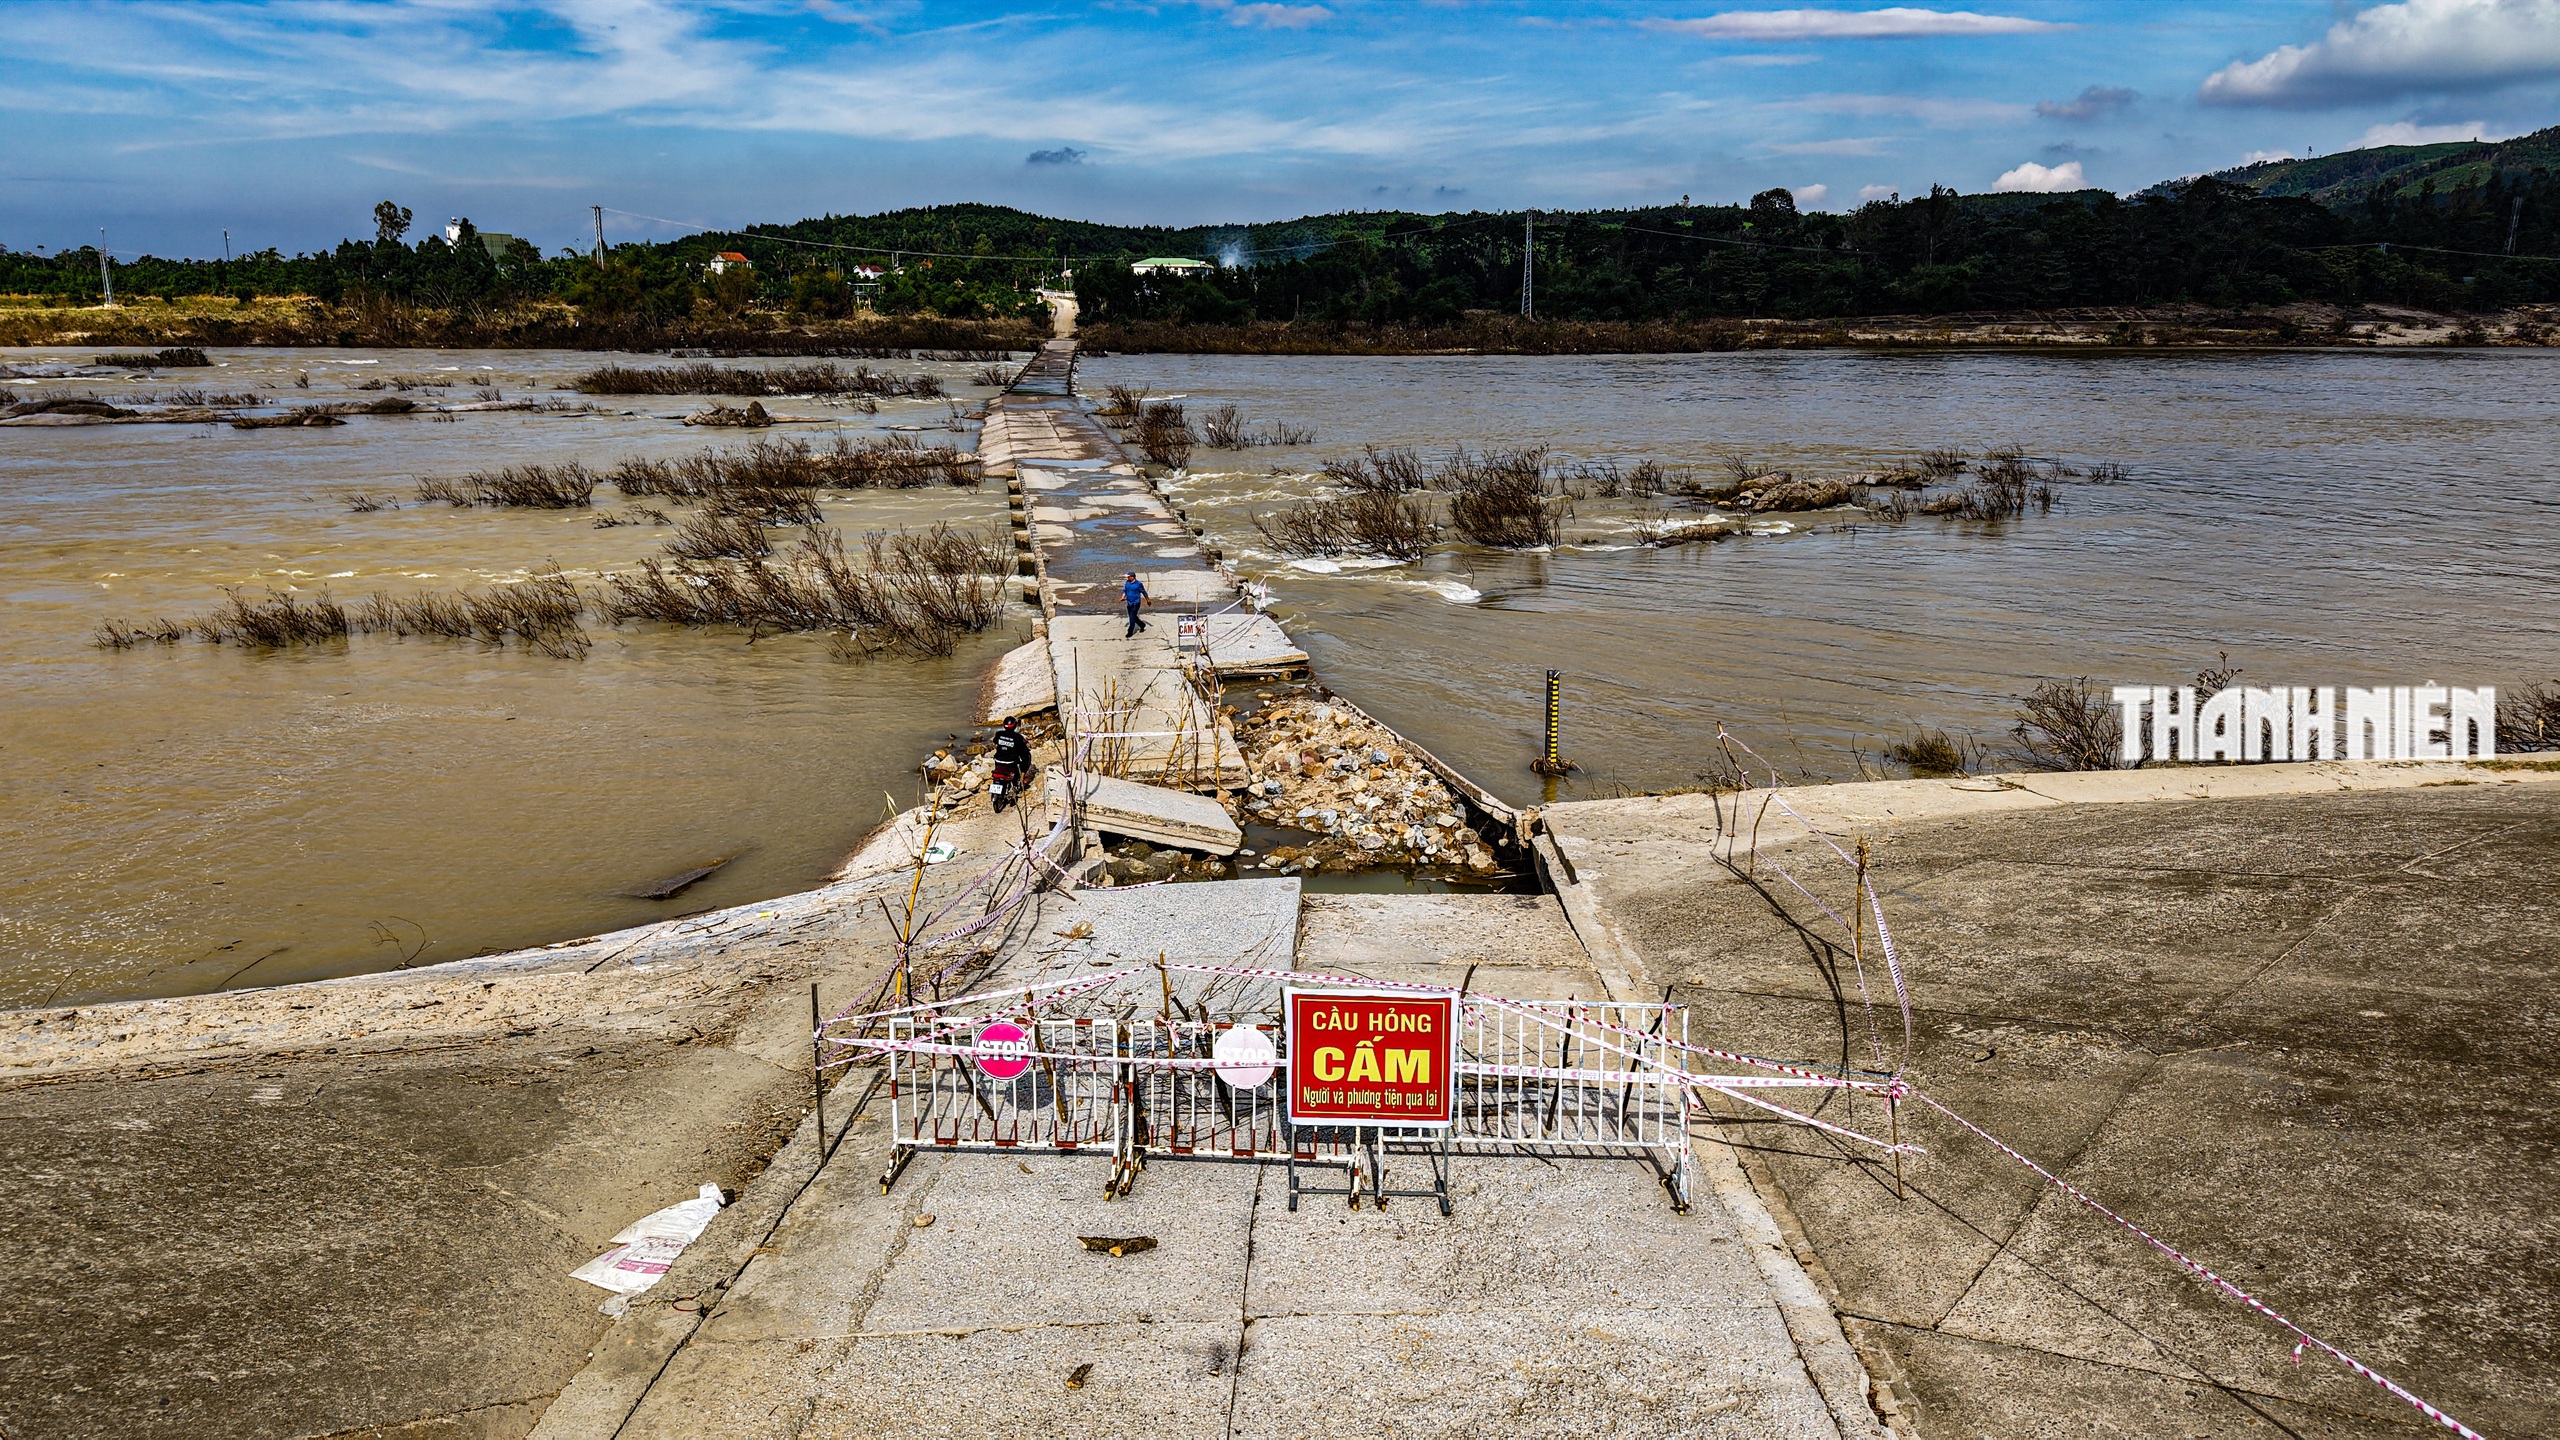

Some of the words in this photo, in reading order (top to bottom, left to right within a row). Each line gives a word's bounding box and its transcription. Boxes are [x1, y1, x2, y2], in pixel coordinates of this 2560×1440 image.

[1312, 1005, 1358, 1031] CẦU
[1368, 1007, 1432, 1033] HỎNG
[978, 1039, 1029, 1062] STOP
[1219, 1046, 1271, 1061] STOP
[1313, 1035, 1431, 1084] CẤM
[1303, 1086, 1330, 1107] Người
[1333, 1087, 1344, 1104] và
[1347, 1088, 1382, 1109] phương
[1384, 1089, 1402, 1109] tiện
[1405, 1092, 1423, 1110] qua
[1425, 1089, 1438, 1110] lại
